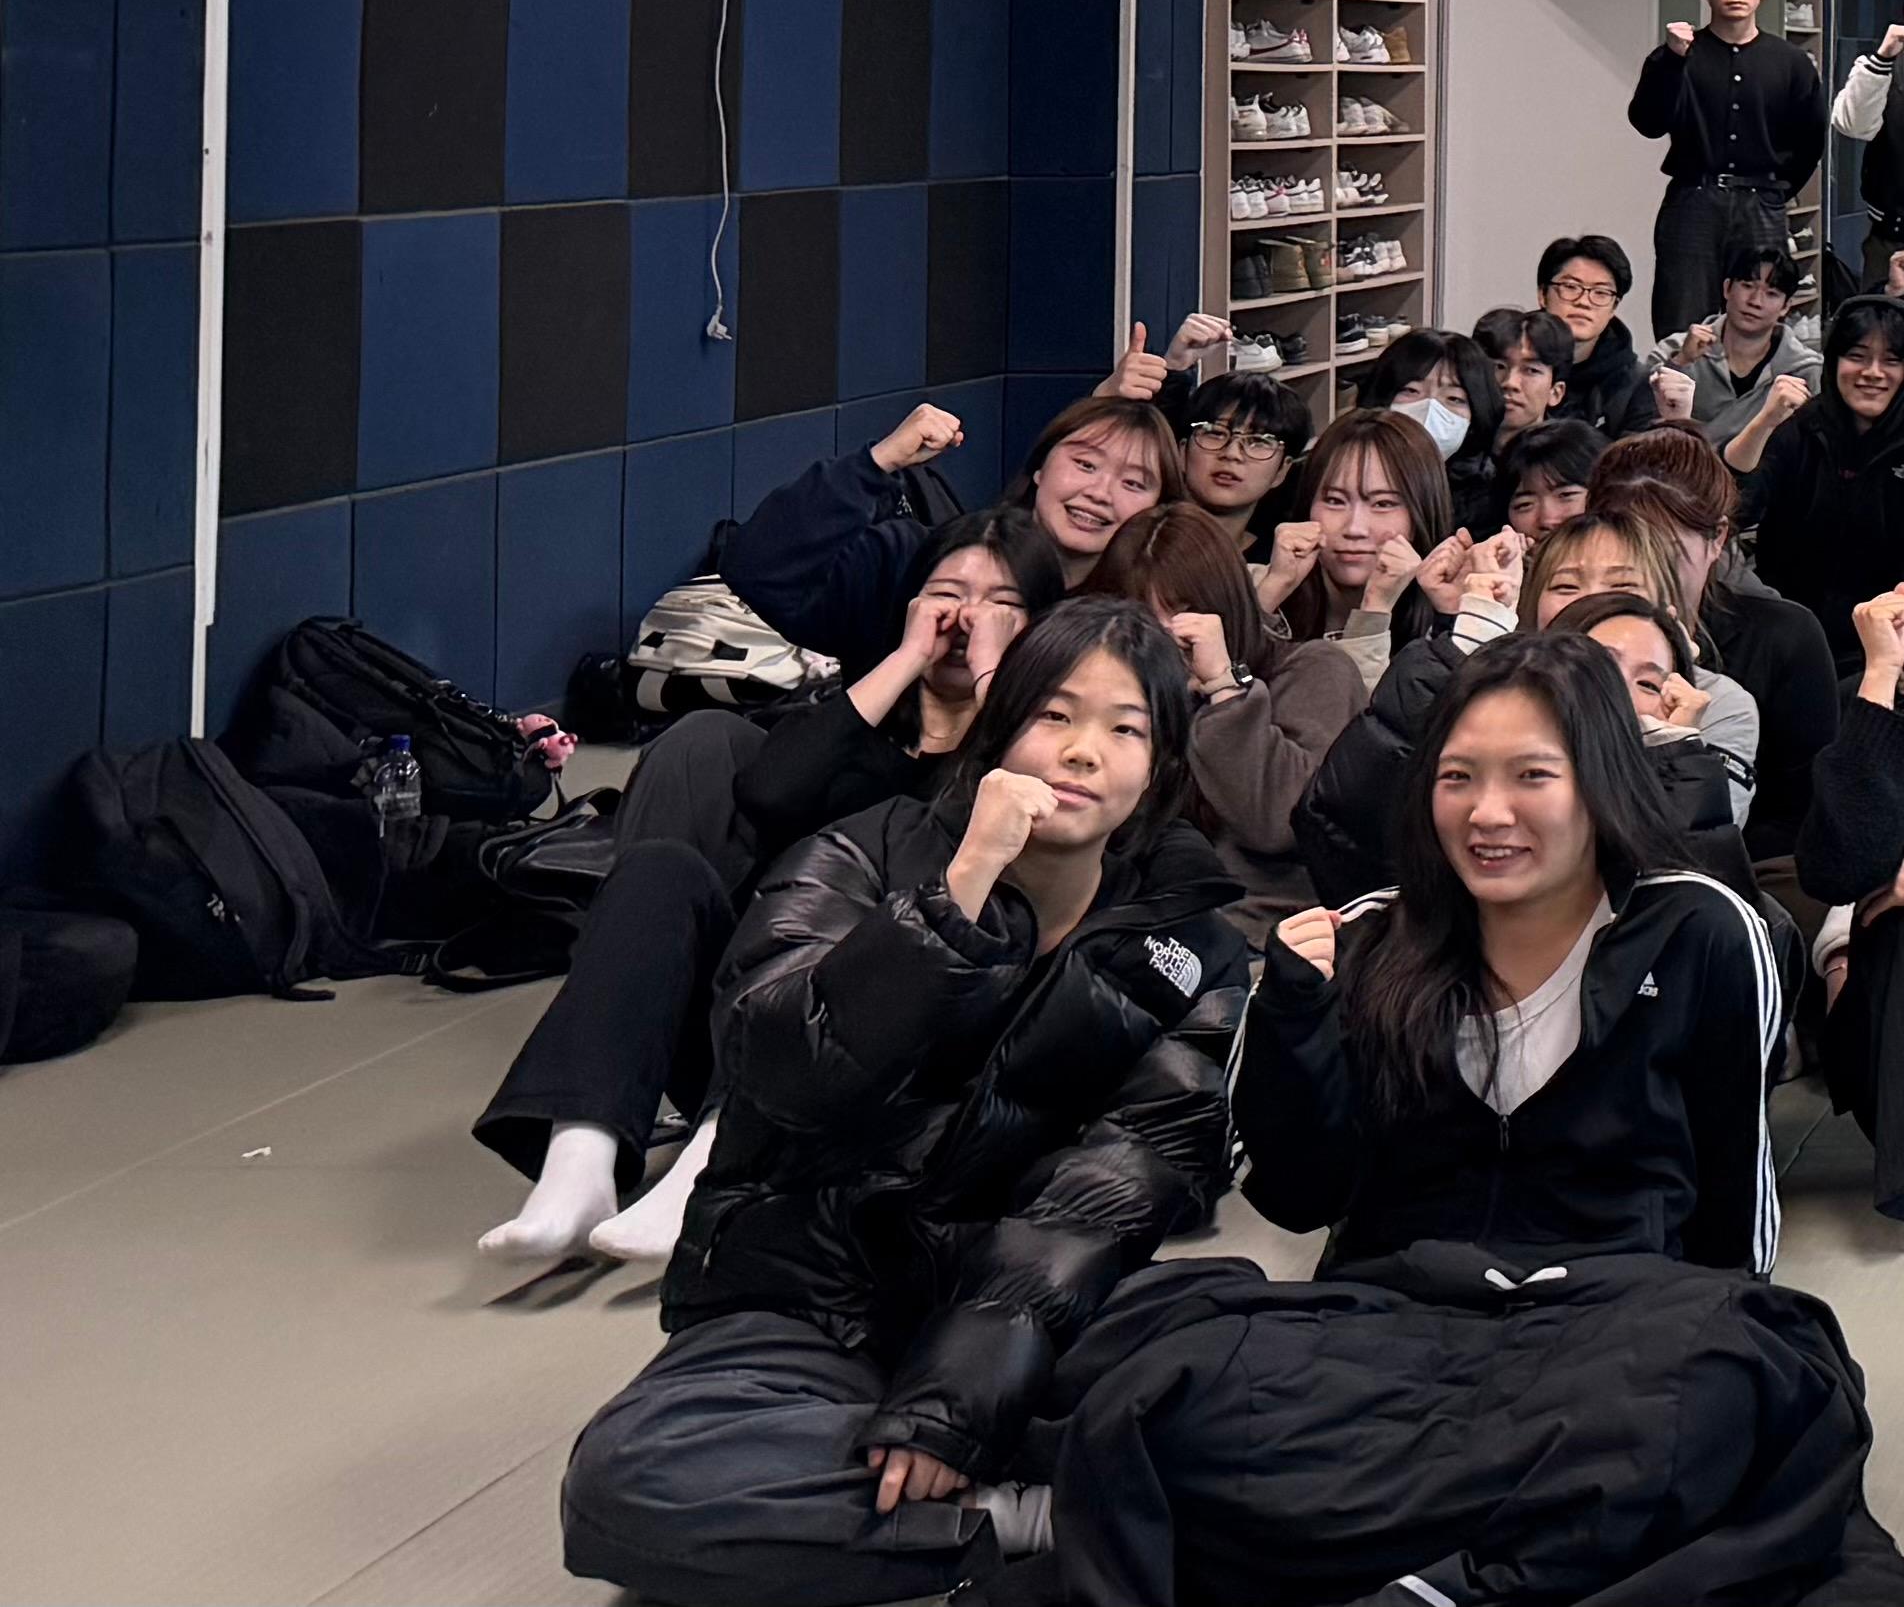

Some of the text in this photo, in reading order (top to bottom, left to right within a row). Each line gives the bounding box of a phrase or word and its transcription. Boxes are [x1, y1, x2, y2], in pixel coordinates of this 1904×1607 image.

[1143, 935, 1187, 971] NORTH
[1168, 936, 1192, 962] THE
[1149, 953, 1180, 983] FACE
